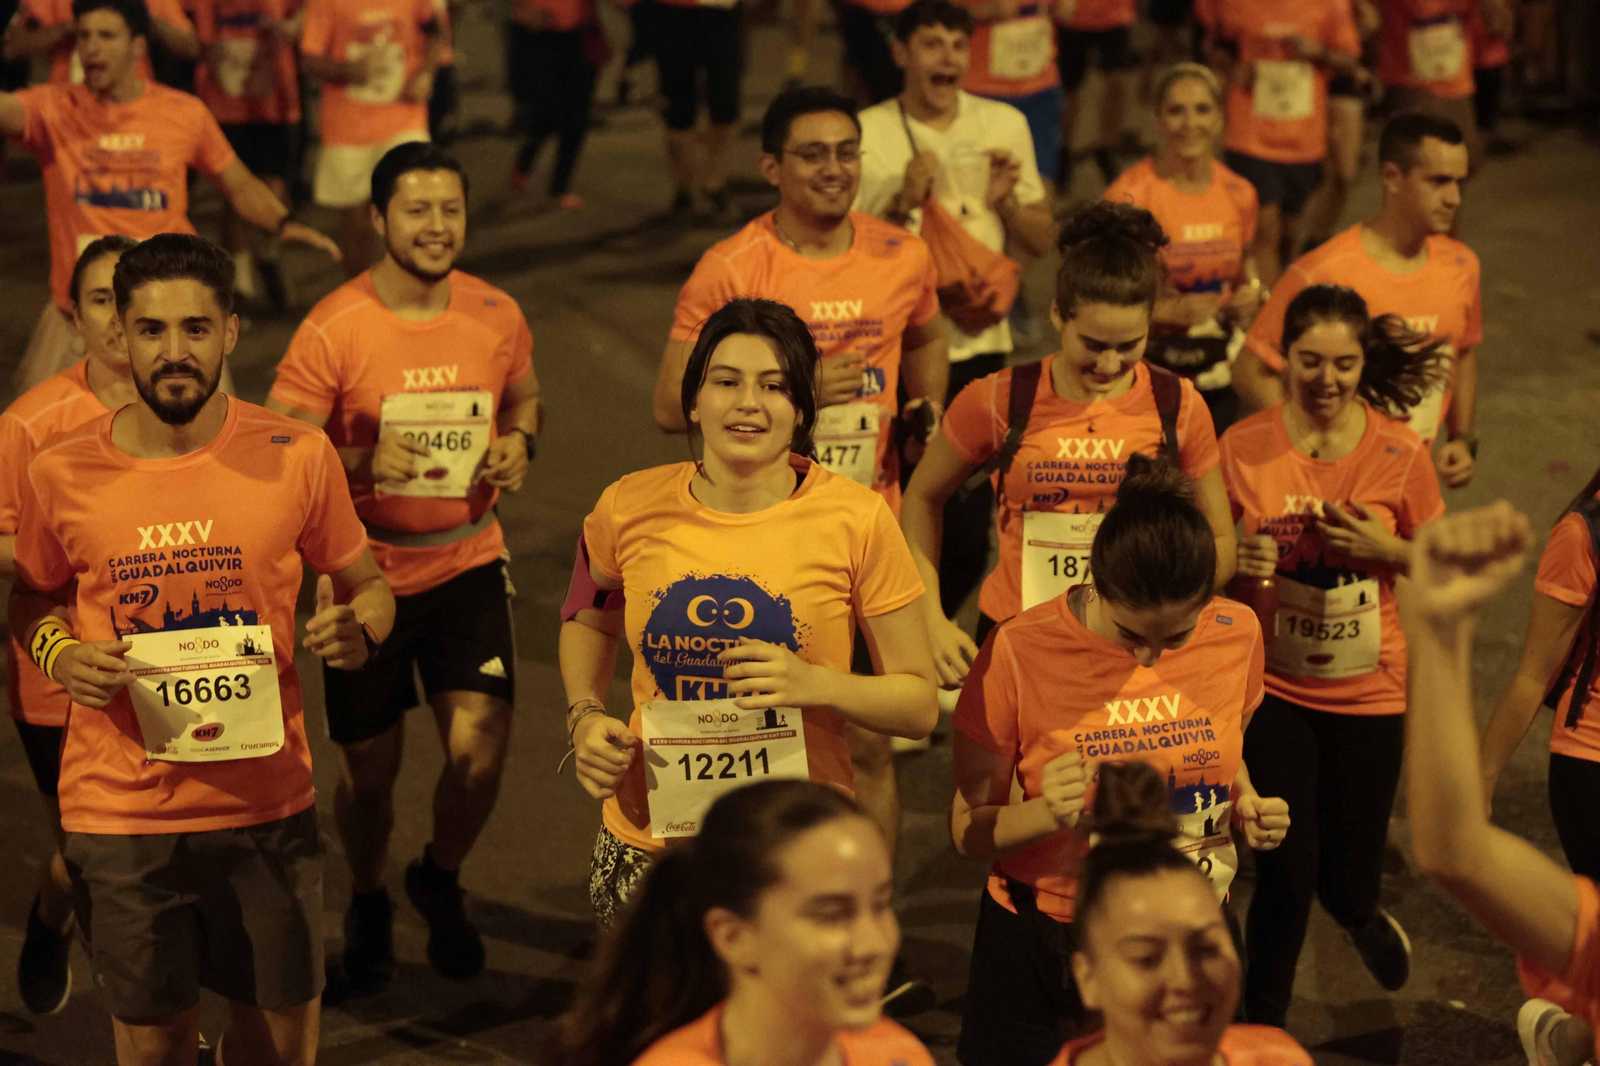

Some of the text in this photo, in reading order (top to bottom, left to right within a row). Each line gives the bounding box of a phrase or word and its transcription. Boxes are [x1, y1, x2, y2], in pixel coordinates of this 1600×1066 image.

[810, 299, 863, 320] XXXV
[403, 364, 458, 389] XXXV
[820, 446, 861, 465] 477
[1056, 437, 1124, 460] XXXV
[1028, 461, 1128, 471] CARRERA NOCTU
[137, 519, 213, 550] XXXV
[108, 545, 243, 568] CARRERA NOCTURNA
[1048, 554, 1090, 578] 187
[118, 558, 243, 581] GUADALQUIVIR
[1287, 614, 1361, 641] 19523
[647, 633, 671, 649] LA
[653, 650, 672, 664] del
[156, 673, 252, 707] 16663
[1106, 693, 1180, 726] XXXV
[729, 733, 768, 743] GUADALQUIVIR
[1074, 716, 1212, 743] CARRERA NOCTURNA
[241, 741, 279, 750] Cruzcampo
[1086, 728, 1216, 757] GUADALQUIVIR
[678, 747, 769, 781] 12211
